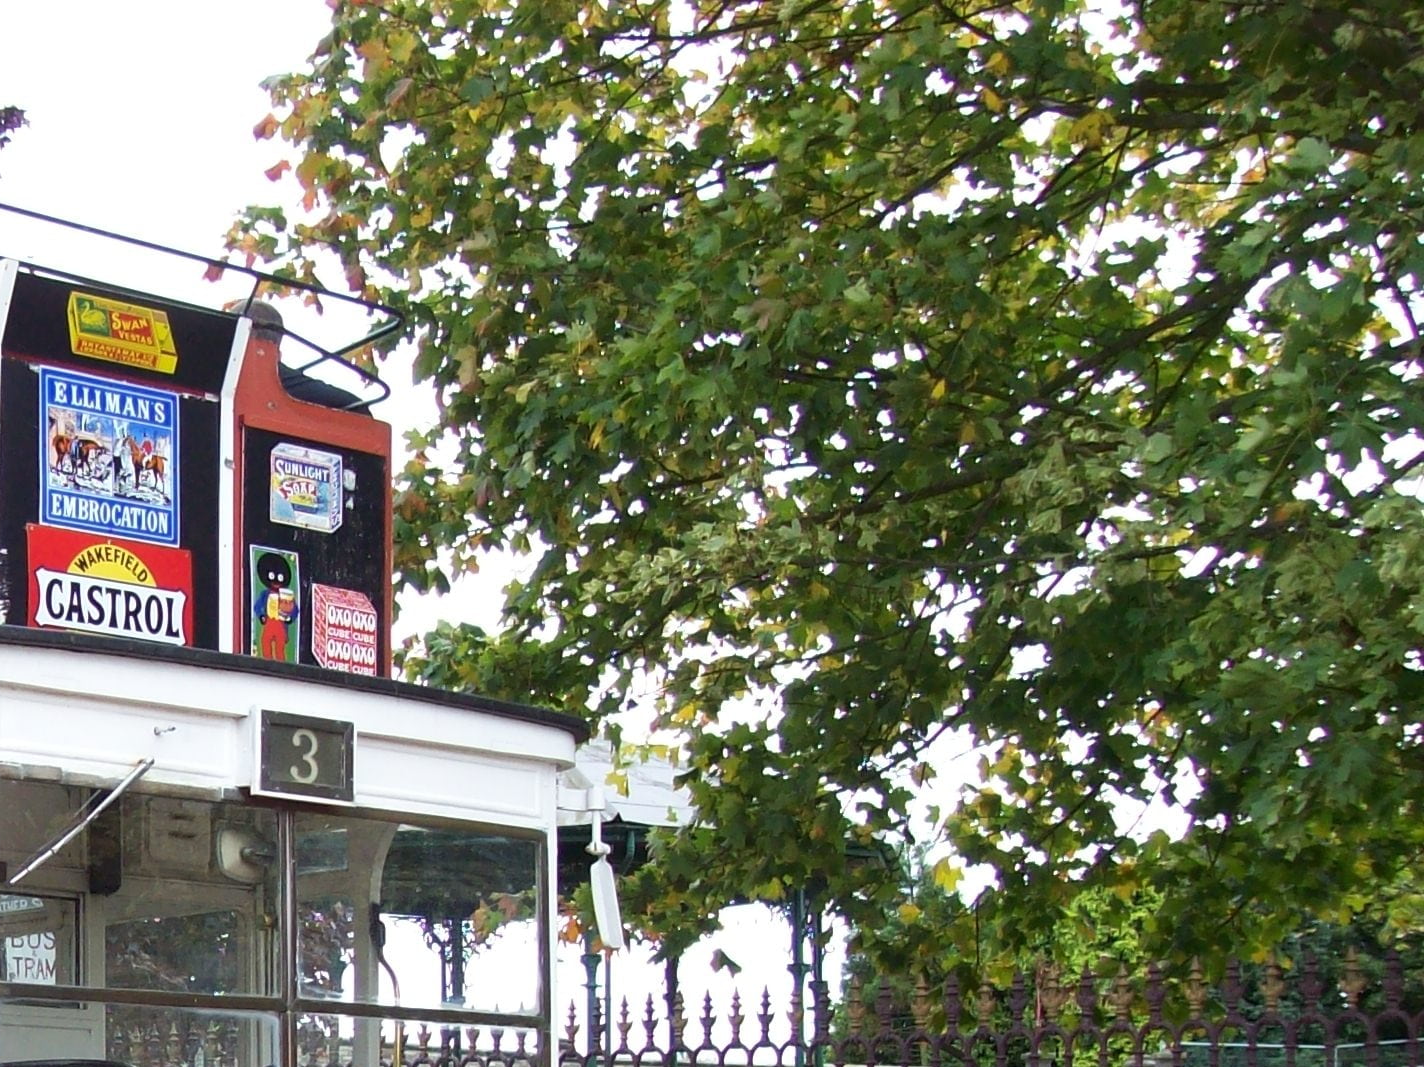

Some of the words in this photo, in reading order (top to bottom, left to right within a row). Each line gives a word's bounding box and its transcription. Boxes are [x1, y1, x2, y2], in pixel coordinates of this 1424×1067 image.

[111, 312, 149, 331] SWAN
[117, 330, 153, 345] VESTAS
[54, 380, 167, 424] ELLIMAN'S
[275, 459, 330, 482] SUNLIGHT
[282, 481, 315, 497] SOAP
[50, 493, 169, 535] EMBROCATION
[74, 545, 149, 584] WAKEFIELD
[45, 577, 181, 639] CASTROL
[328, 606, 351, 628] OXO
[352, 611, 375, 632] OXO
[327, 627, 351, 639] CUBE
[352, 632, 375, 643] CUBE
[327, 639, 351, 661] OXO
[352, 644, 375, 665] OXO
[327, 660, 350, 672] CUBE
[352, 665, 374, 676] CUBE
[290, 728, 319, 784] 3
[11, 932, 56, 950] BUS
[12, 957, 56, 980] TRAM
